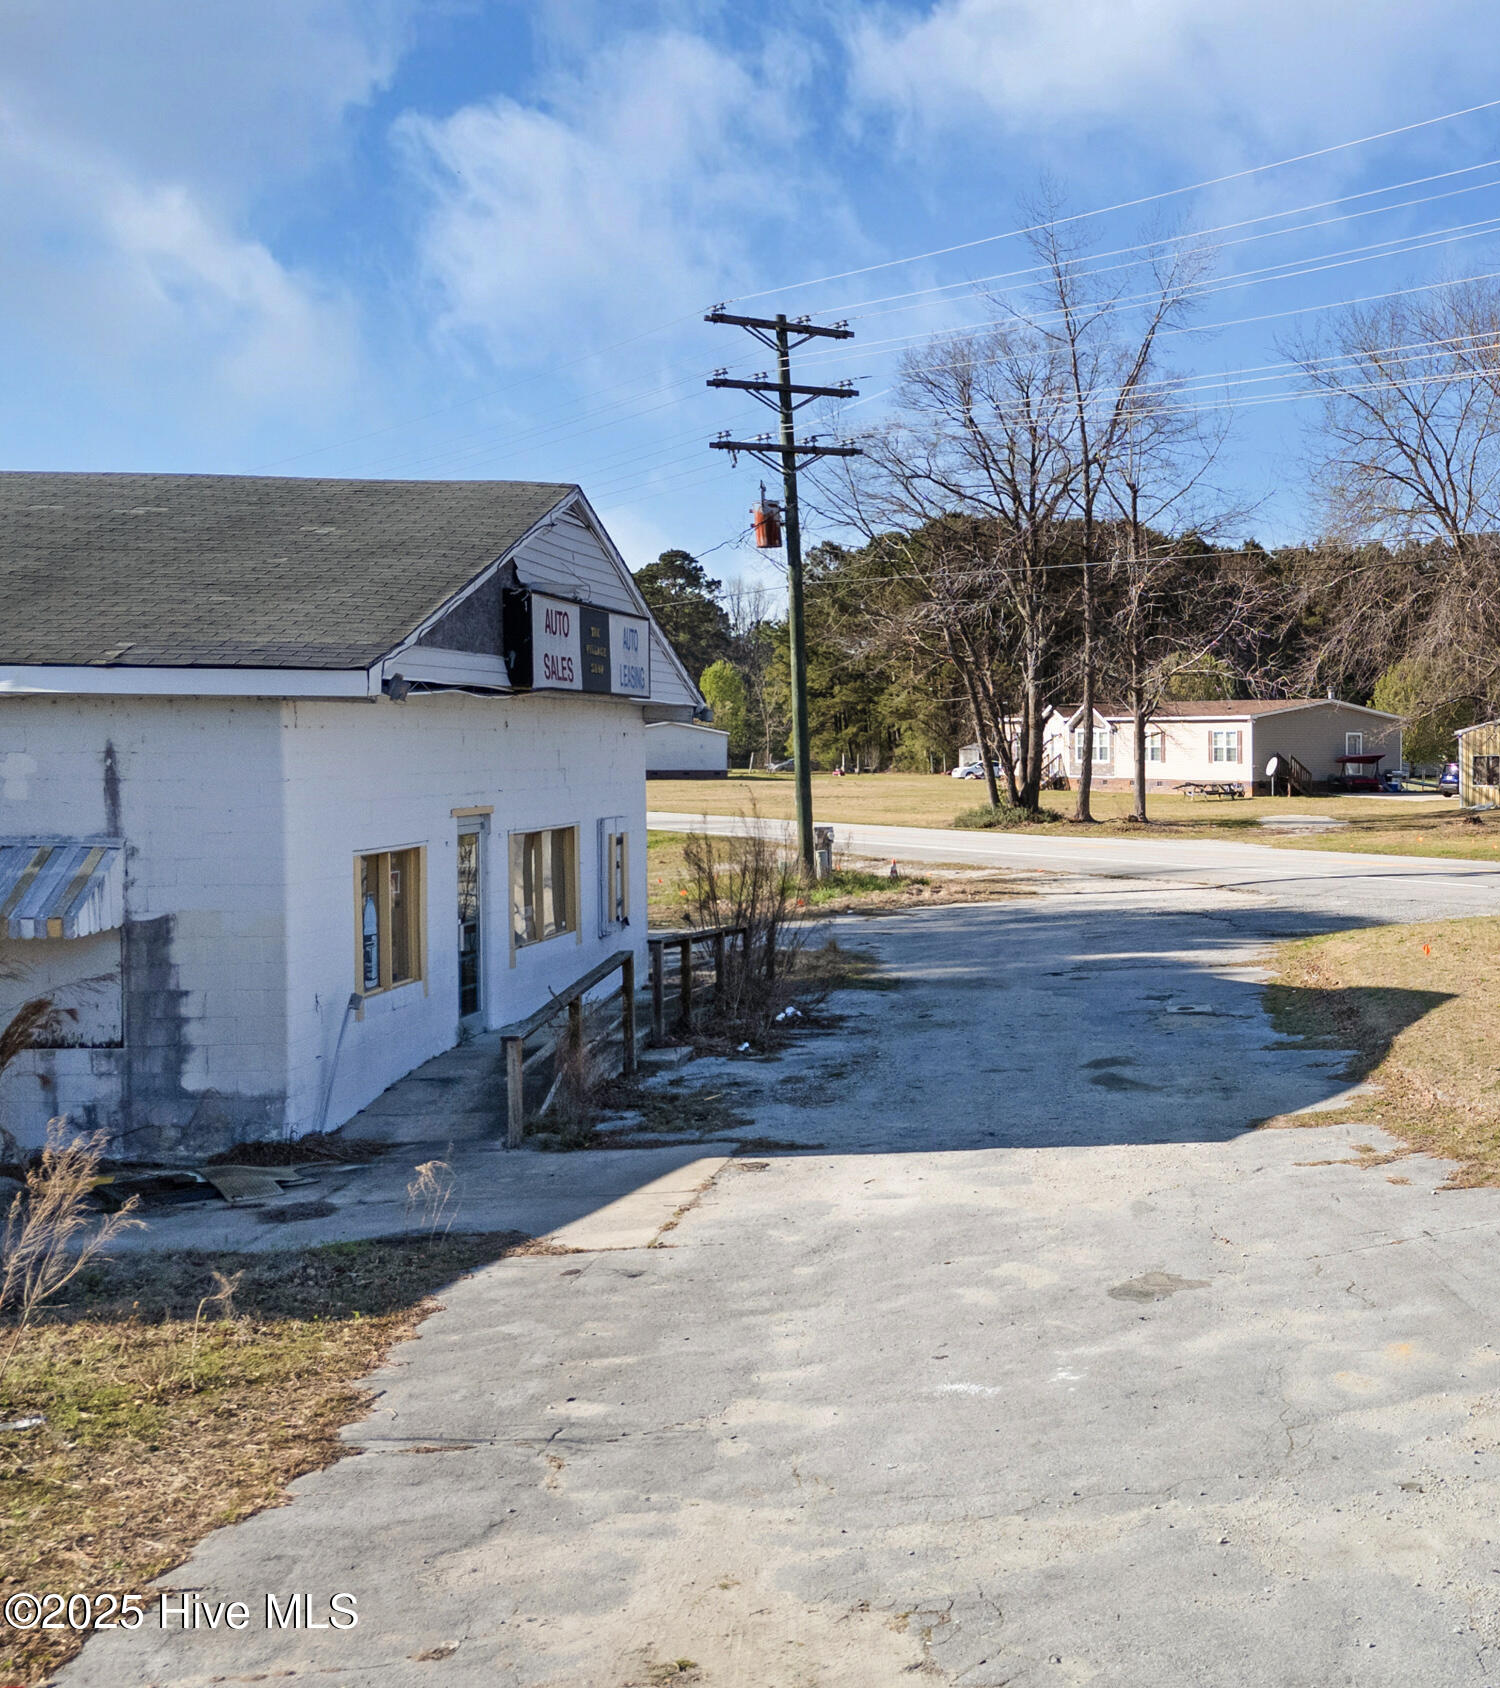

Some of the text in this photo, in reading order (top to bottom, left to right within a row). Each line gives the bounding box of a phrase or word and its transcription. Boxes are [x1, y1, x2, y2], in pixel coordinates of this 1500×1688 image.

[545, 608, 570, 638] AUTO
[623, 627, 638, 652] AUTO
[543, 653, 575, 683] SALES
[620, 664, 645, 689] LEASING
